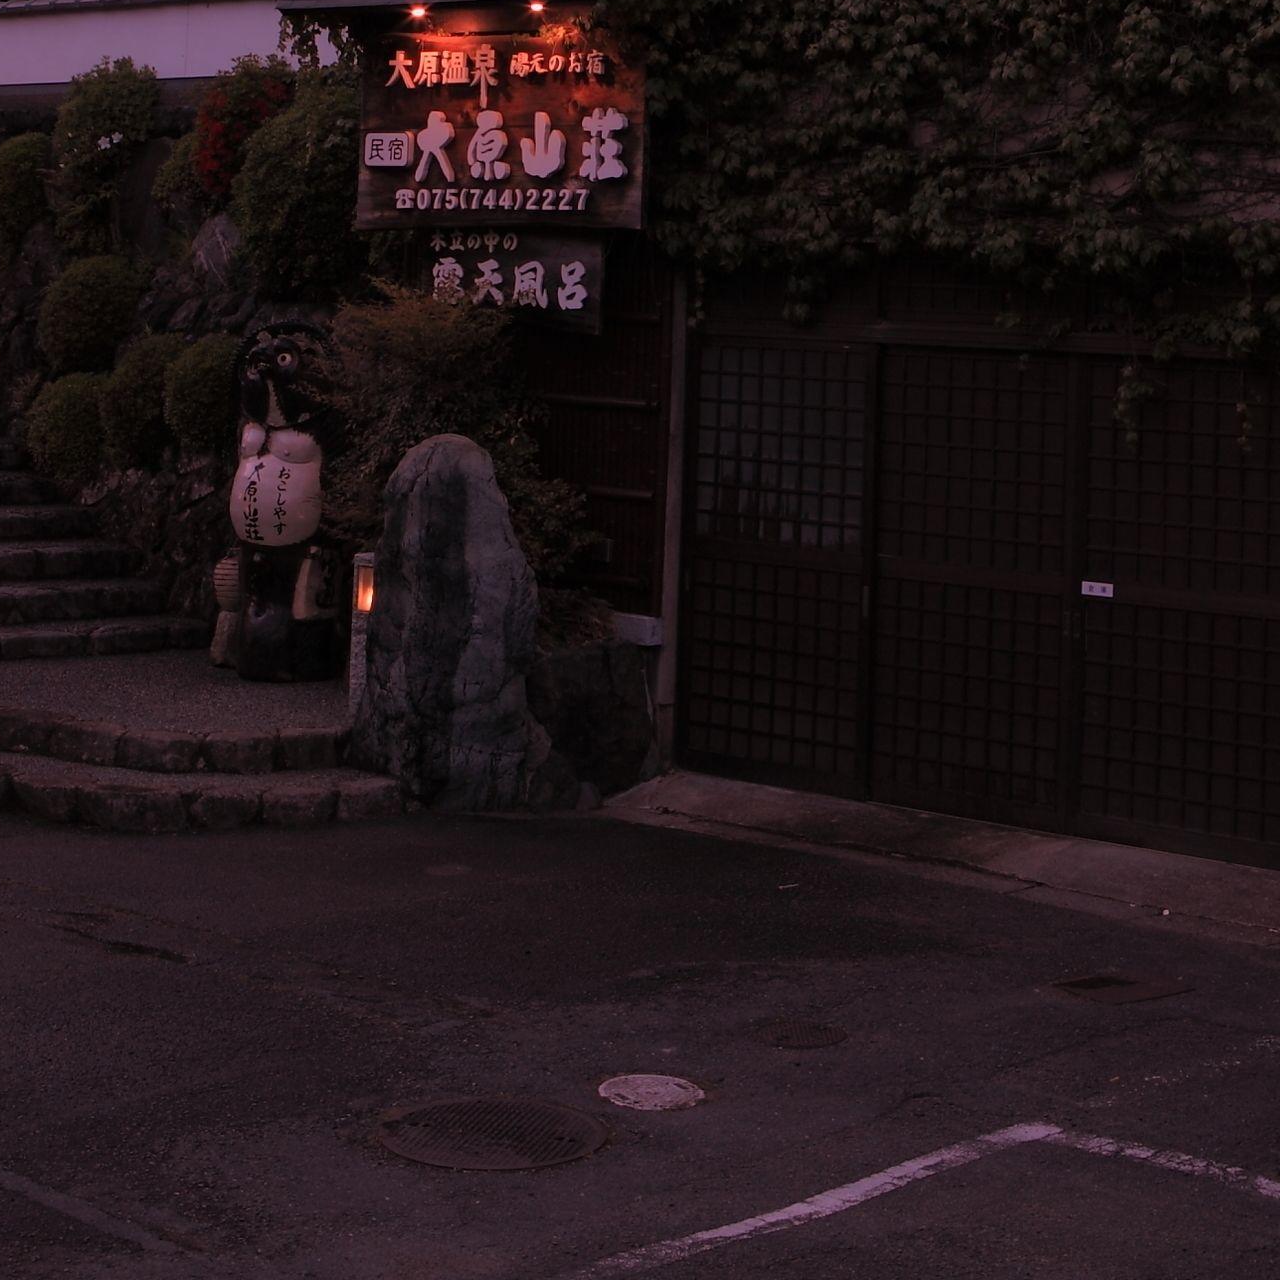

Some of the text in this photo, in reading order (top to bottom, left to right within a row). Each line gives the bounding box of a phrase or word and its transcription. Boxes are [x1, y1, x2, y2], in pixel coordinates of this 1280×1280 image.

[385, 44, 498, 108] 大原温泉
[369, 138, 404, 162] 民宿
[414, 107, 630, 183] 大原山荘
[416, 189, 592, 212] 075(744)2227
[429, 228, 518, 254] 木立の中の
[431, 257, 588, 310] 露天風呂
[273, 467, 290, 536] おこしやす
